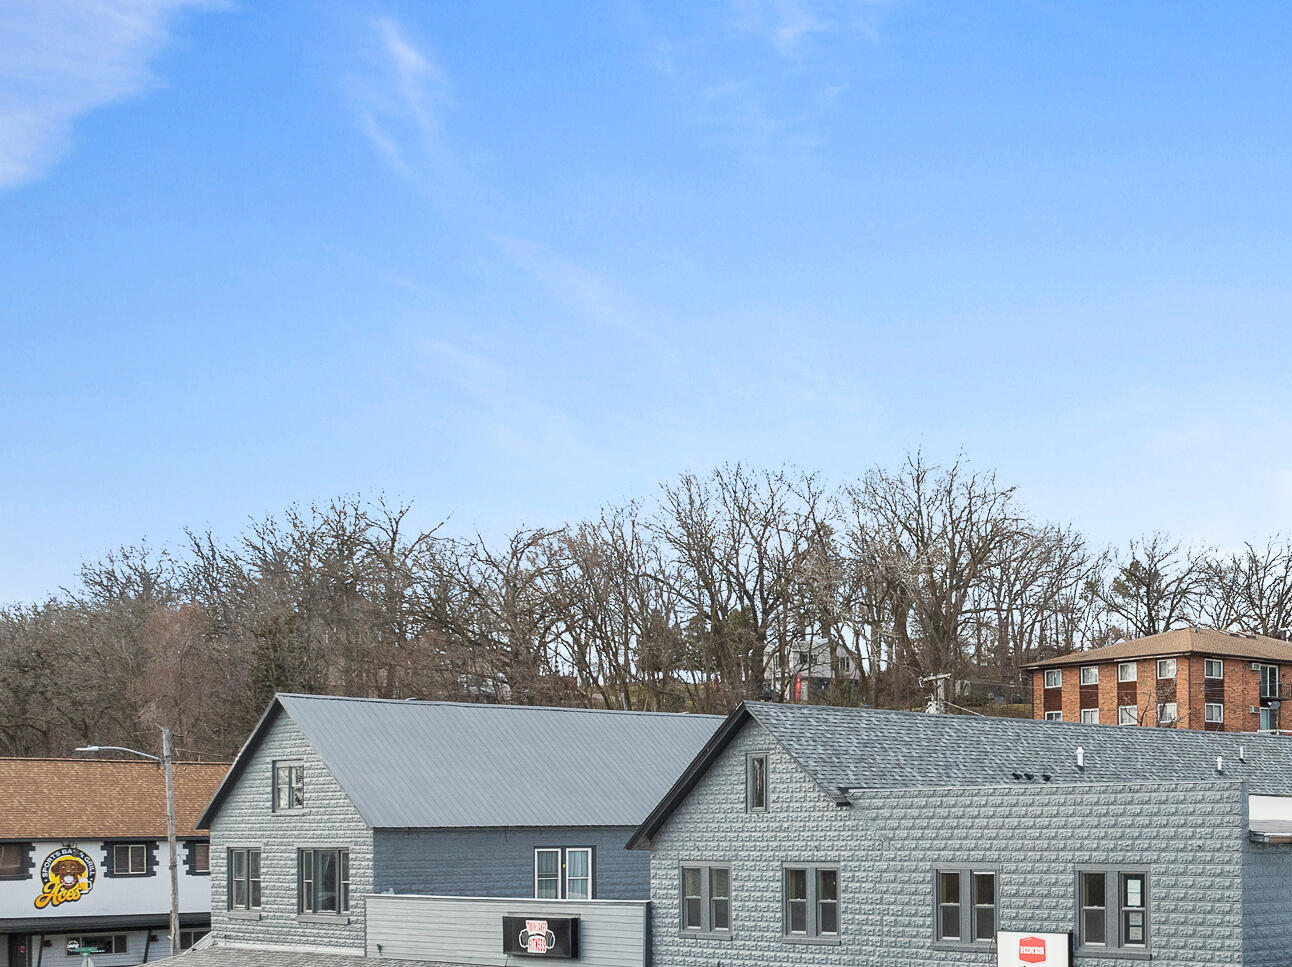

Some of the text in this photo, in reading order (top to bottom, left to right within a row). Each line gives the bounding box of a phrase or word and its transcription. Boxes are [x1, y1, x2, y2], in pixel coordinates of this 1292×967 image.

[42, 852, 61, 878] SPORTS
[85, 856, 95, 876] GRILL
[35, 882, 81, 908] Aces
[529, 938, 546, 952] FITNESS
[1020, 946, 1044, 955] HINES
